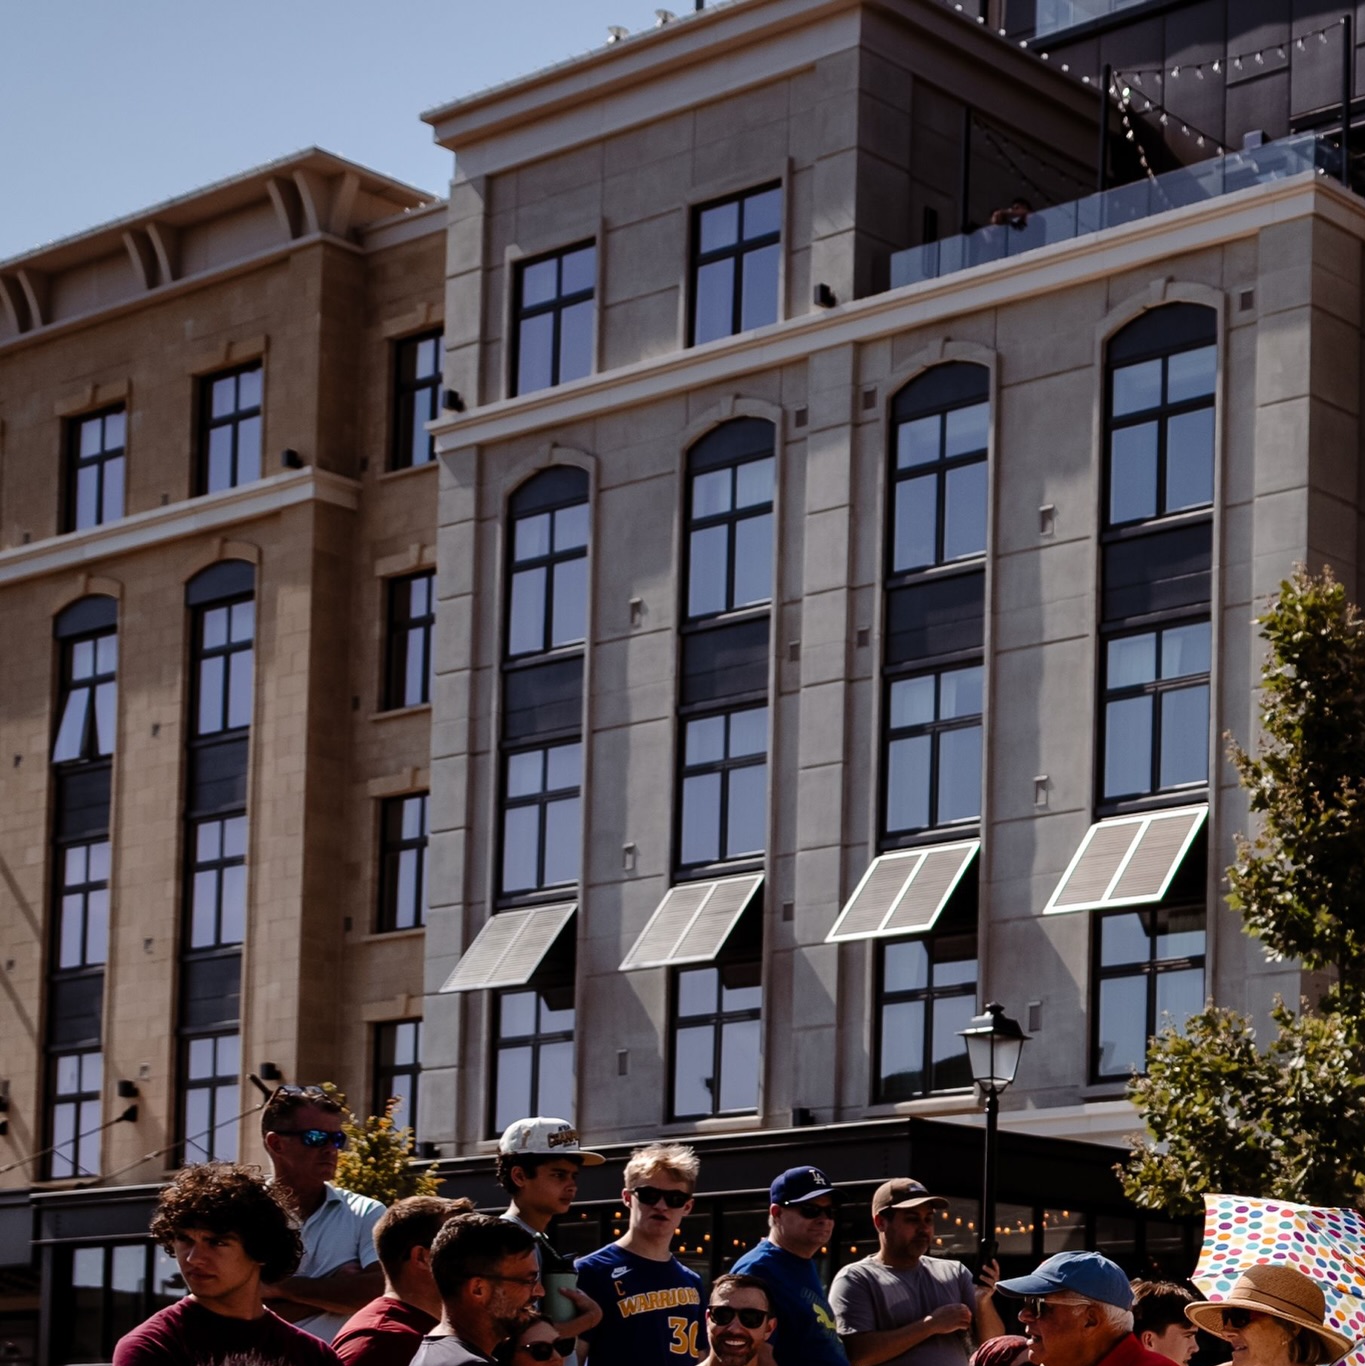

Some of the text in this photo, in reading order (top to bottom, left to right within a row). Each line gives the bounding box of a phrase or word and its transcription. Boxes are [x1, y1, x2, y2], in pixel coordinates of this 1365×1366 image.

[808, 1169, 826, 1185] LA
[614, 1280, 626, 1296] C
[617, 1287, 700, 1318] WARRIOR
